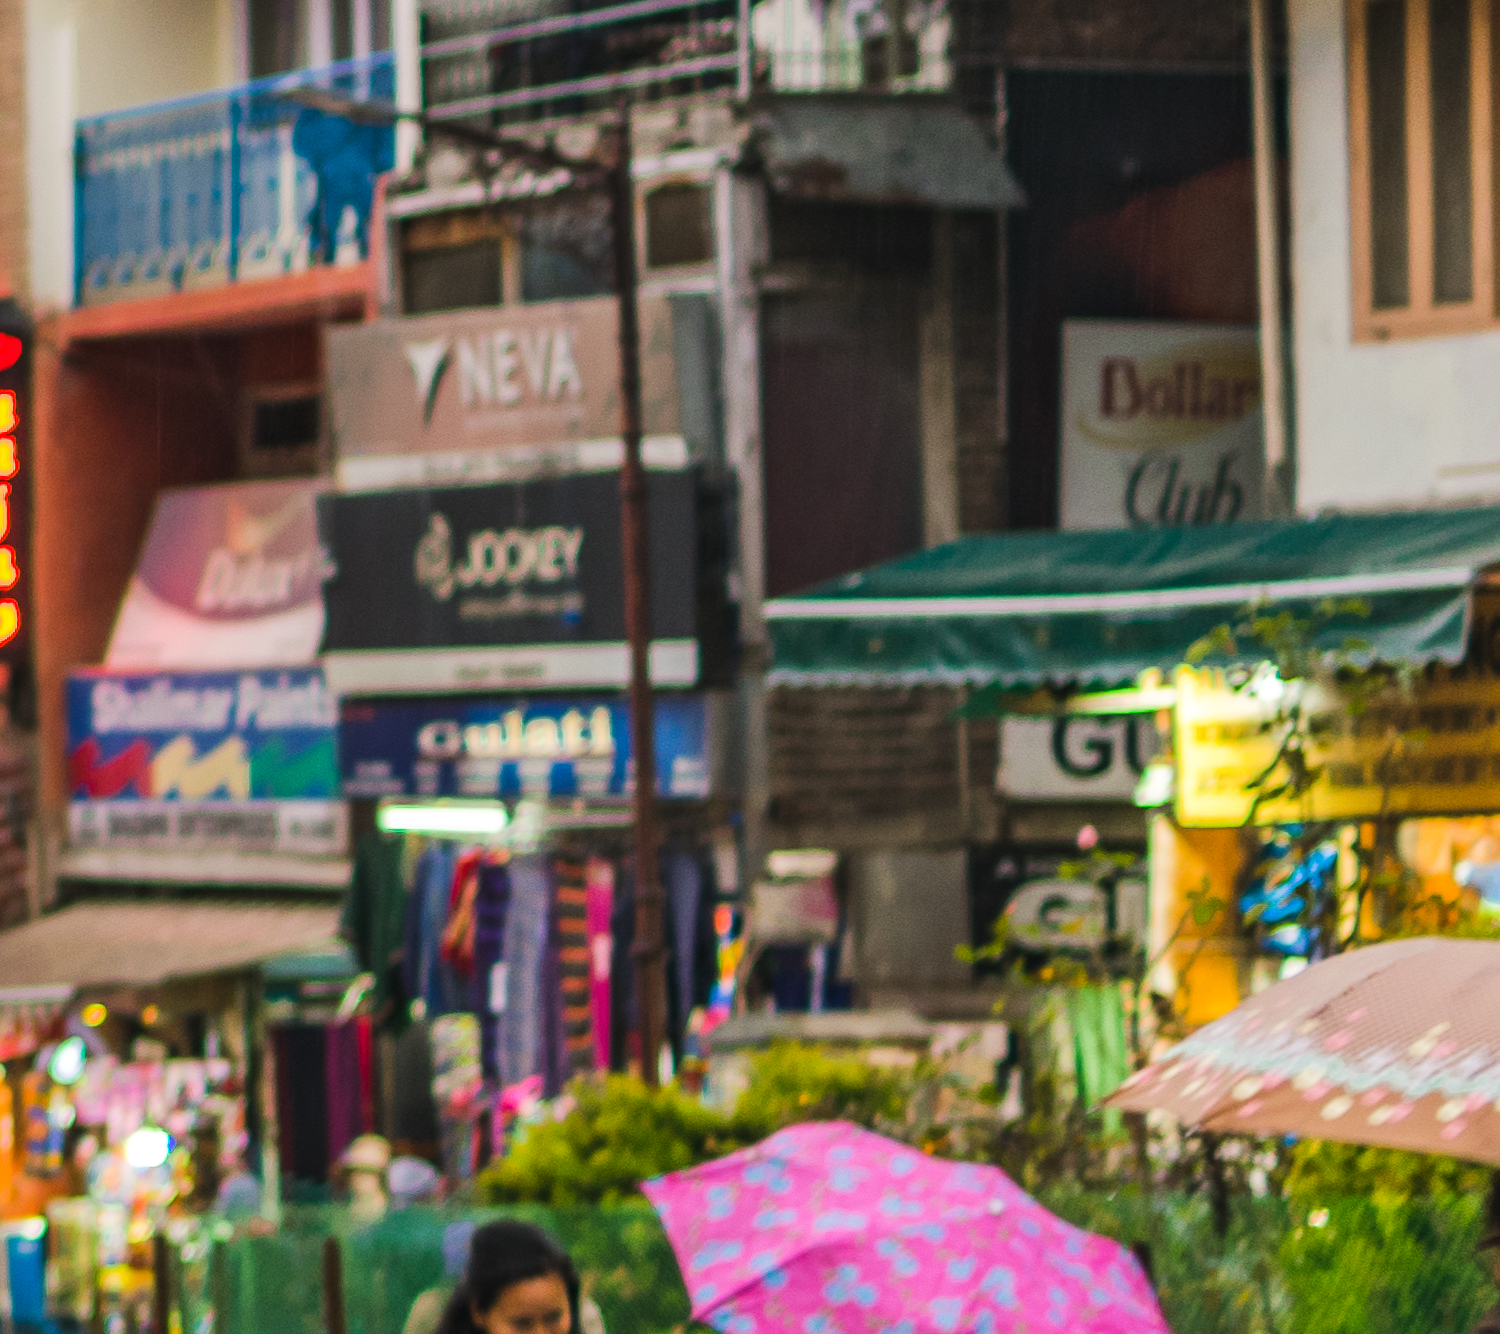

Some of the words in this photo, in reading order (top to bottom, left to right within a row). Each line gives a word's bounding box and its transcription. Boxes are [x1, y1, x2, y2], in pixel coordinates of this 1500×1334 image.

[457, 327, 584, 408] NEVA
[1101, 354, 1259, 421] Dollar
[1126, 454, 1244, 528] Club
[91, 678, 233, 735] Shalimar
[416, 705, 613, 759] Gulati
